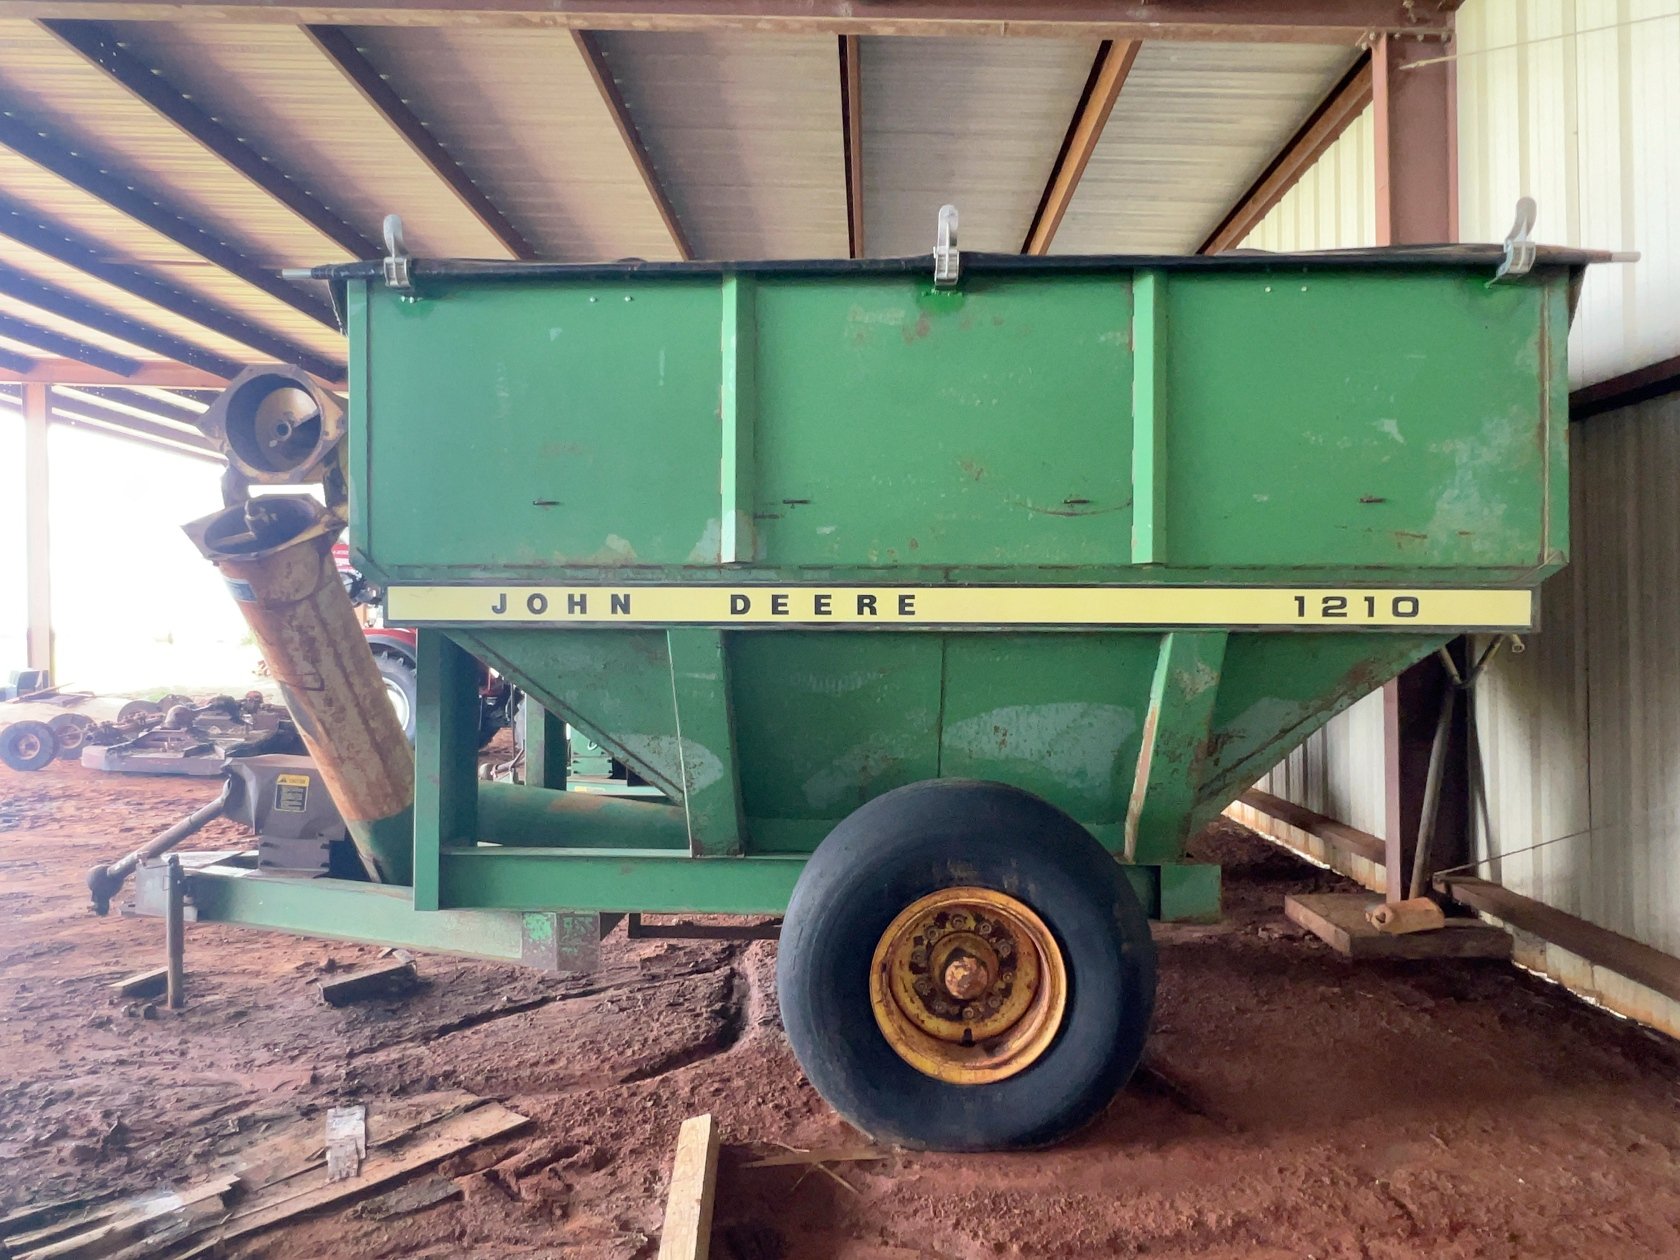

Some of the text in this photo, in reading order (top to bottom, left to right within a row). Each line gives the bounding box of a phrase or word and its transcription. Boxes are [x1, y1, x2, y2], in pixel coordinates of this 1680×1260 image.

[491, 593, 917, 616] JOHN DEERE
[1294, 595, 1420, 618] 1210
